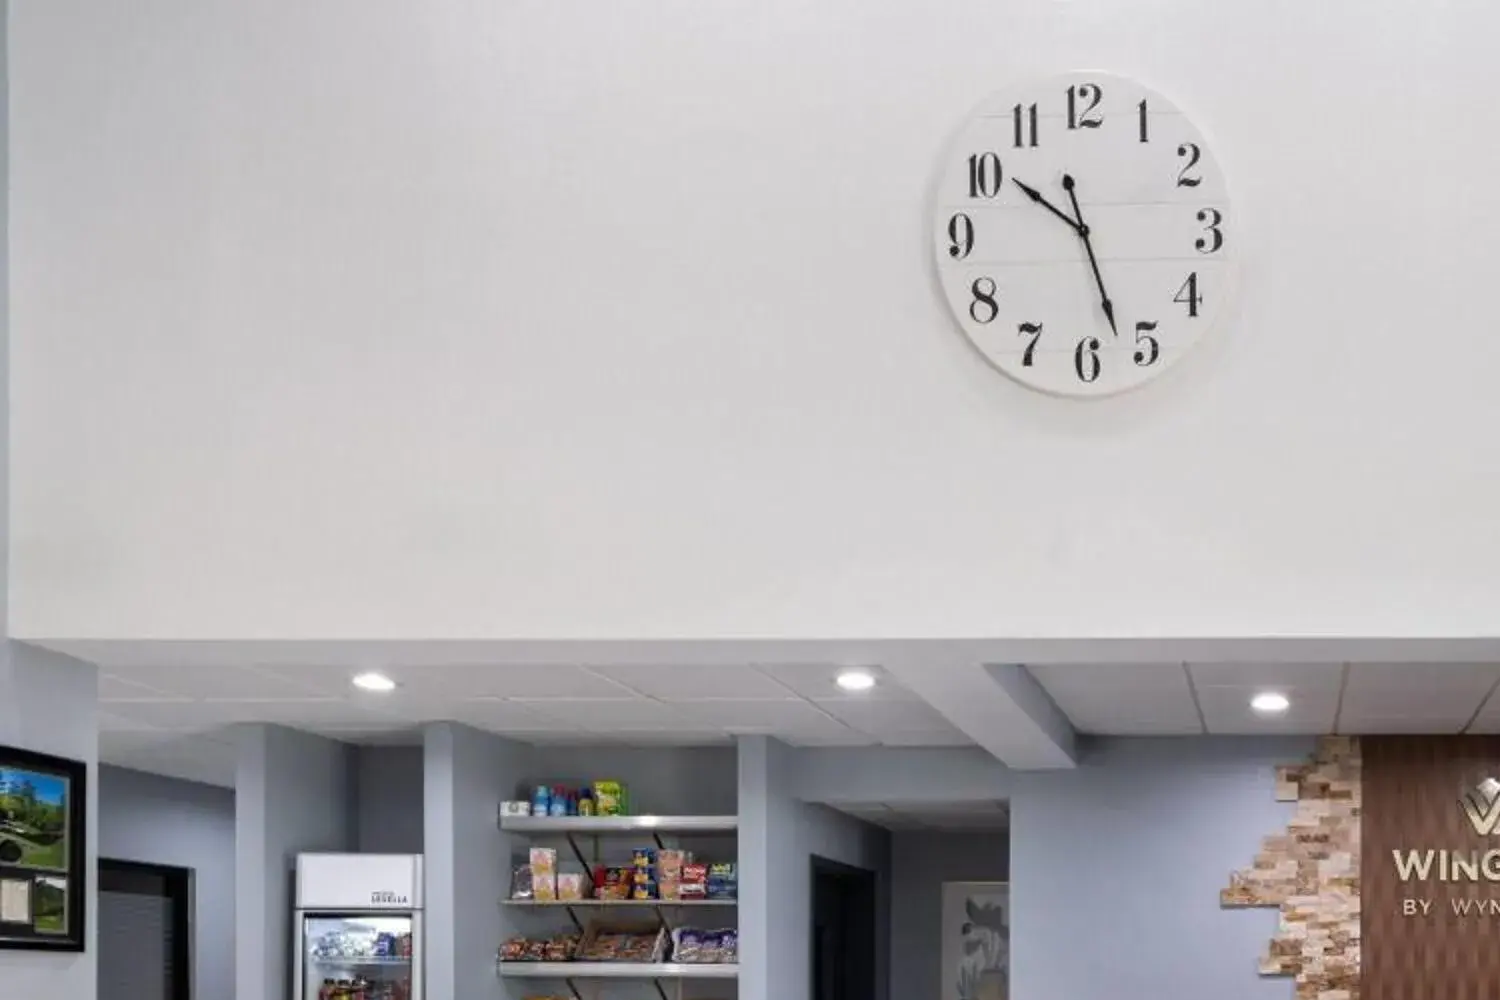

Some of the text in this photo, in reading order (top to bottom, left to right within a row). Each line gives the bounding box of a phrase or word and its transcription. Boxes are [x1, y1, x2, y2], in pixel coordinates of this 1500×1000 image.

[1012, 103, 1039, 148] 11
[1065, 83, 1103, 130] 12
[1137, 98, 1149, 143] 1
[967, 151, 1003, 199] 10
[1176, 142, 1202, 188] 2
[947, 212, 975, 259] 9
[1194, 207, 1223, 254] 3
[968, 276, 999, 324] 8
[1172, 271, 1203, 318] 4
[1018, 321, 1043, 367] 7
[1073, 336, 1101, 383] 6
[1133, 320, 1159, 366] 5
[1403, 899, 1432, 916] BY
